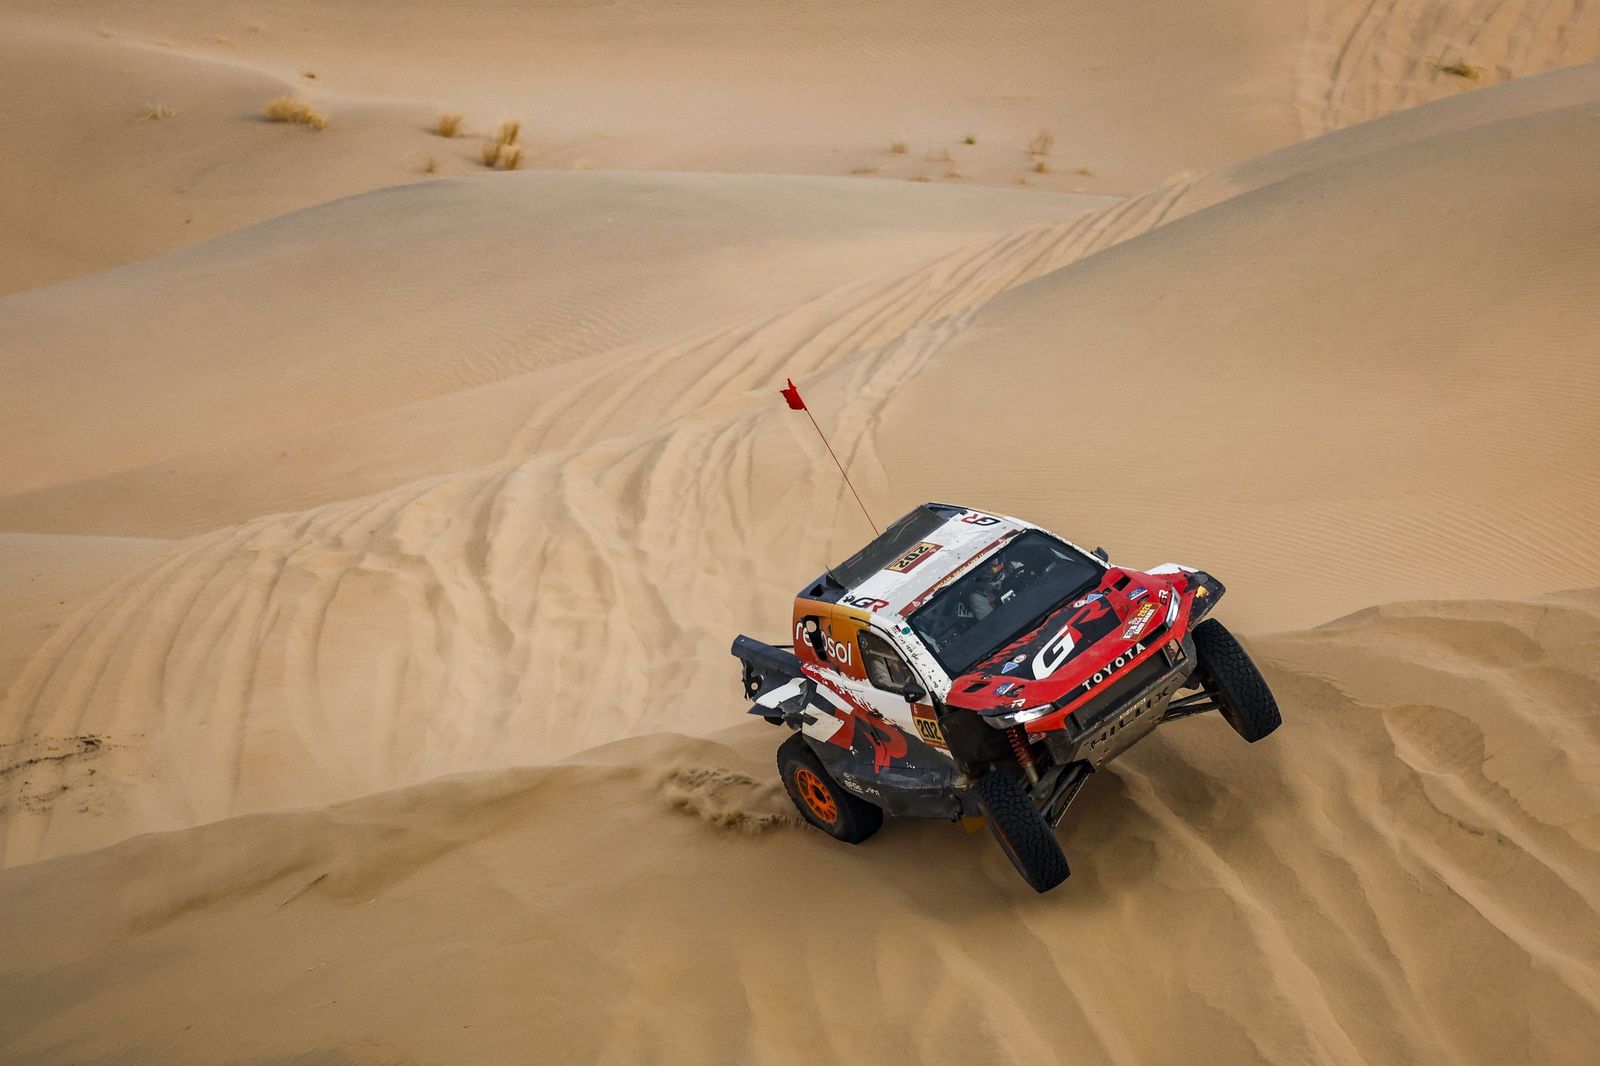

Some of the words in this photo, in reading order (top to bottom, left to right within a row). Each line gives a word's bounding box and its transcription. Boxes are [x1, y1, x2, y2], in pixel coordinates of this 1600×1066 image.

[960, 513, 1001, 526] GR
[898, 545, 929, 568] 202
[849, 597, 890, 613] GR
[1031, 600, 1112, 681] GR
[1081, 642, 1146, 691] TOYOTA
[916, 718, 944, 741] 202
